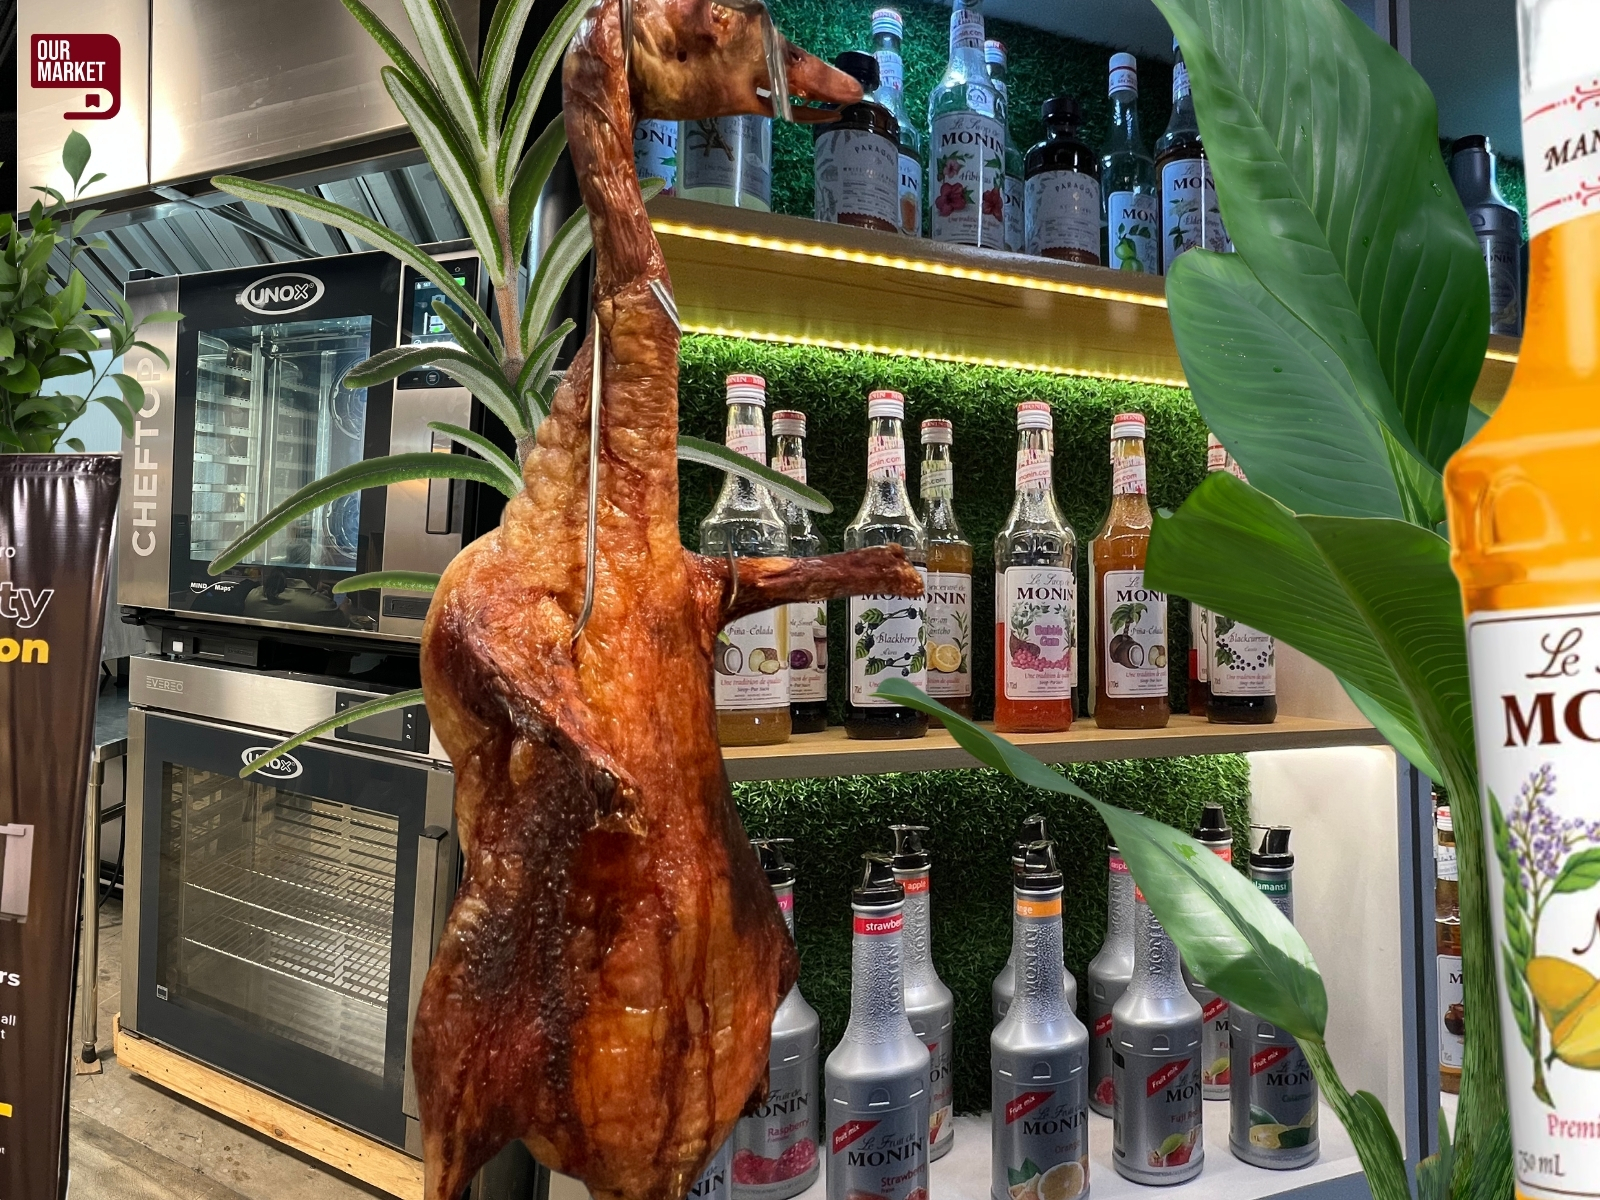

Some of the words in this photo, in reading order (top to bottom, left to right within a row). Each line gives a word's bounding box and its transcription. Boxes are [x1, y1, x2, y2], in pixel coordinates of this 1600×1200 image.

[635, 127, 677, 150] ONI
[941, 131, 1004, 156] MONIN
[959, 170, 991, 184] Hibicus
[1173, 177, 1215, 192] MON
[1122, 208, 1157, 225] MON
[1484, 254, 1513, 264] ONIN
[250, 283, 309, 305] UNOX
[132, 357, 161, 557] CHEFTOP
[927, 583, 958, 591] oncentré
[1026, 573, 1041, 585] Le
[1125, 576, 1140, 588] Le
[927, 592, 966, 604] ONIN
[1017, 587, 1073, 601] MONIN
[1117, 589, 1164, 602] MONI
[876, 631, 917, 646] Blackberry
[1034, 624, 1063, 636] Bubble
[1040, 636, 1060, 646] Gum
[1525, 627, 1583, 679] Le
[146, 675, 184, 694] EVEREO
[248, 752, 292, 773] UOX
[907, 880, 926, 890] apple
[1252, 881, 1287, 891] lamansi
[865, 917, 903, 931] strawbe
[1, 1015, 16, 1026] all
[1219, 1041, 1228, 1049] Fu
[1253, 1057, 1267, 1068] Fruit
[1267, 1051, 1279, 1060] mix
[930, 1061, 952, 1083] ONI
[1151, 1075, 1166, 1089] Fruit
[1167, 1065, 1179, 1077] mix
[1266, 1070, 1314, 1087] MONI
[1165, 1082, 1201, 1103] MON
[748, 1093, 809, 1118] ONIN
[1009, 1103, 1023, 1115] Fruit
[1023, 1095, 1036, 1107] mix
[767, 1117, 810, 1137] Raspberry
[1023, 1107, 1087, 1135] MONIN
[835, 1131, 848, 1145] Fruit
[848, 1124, 860, 1135] mix
[858, 1136, 875, 1151] Le
[877, 1133, 904, 1150] Fruit
[848, 1137, 922, 1167] MONIN
[1538, 1153, 1566, 1177] mL
[691, 1169, 725, 1197] NIN
[881, 1163, 926, 1187] Strawberry
